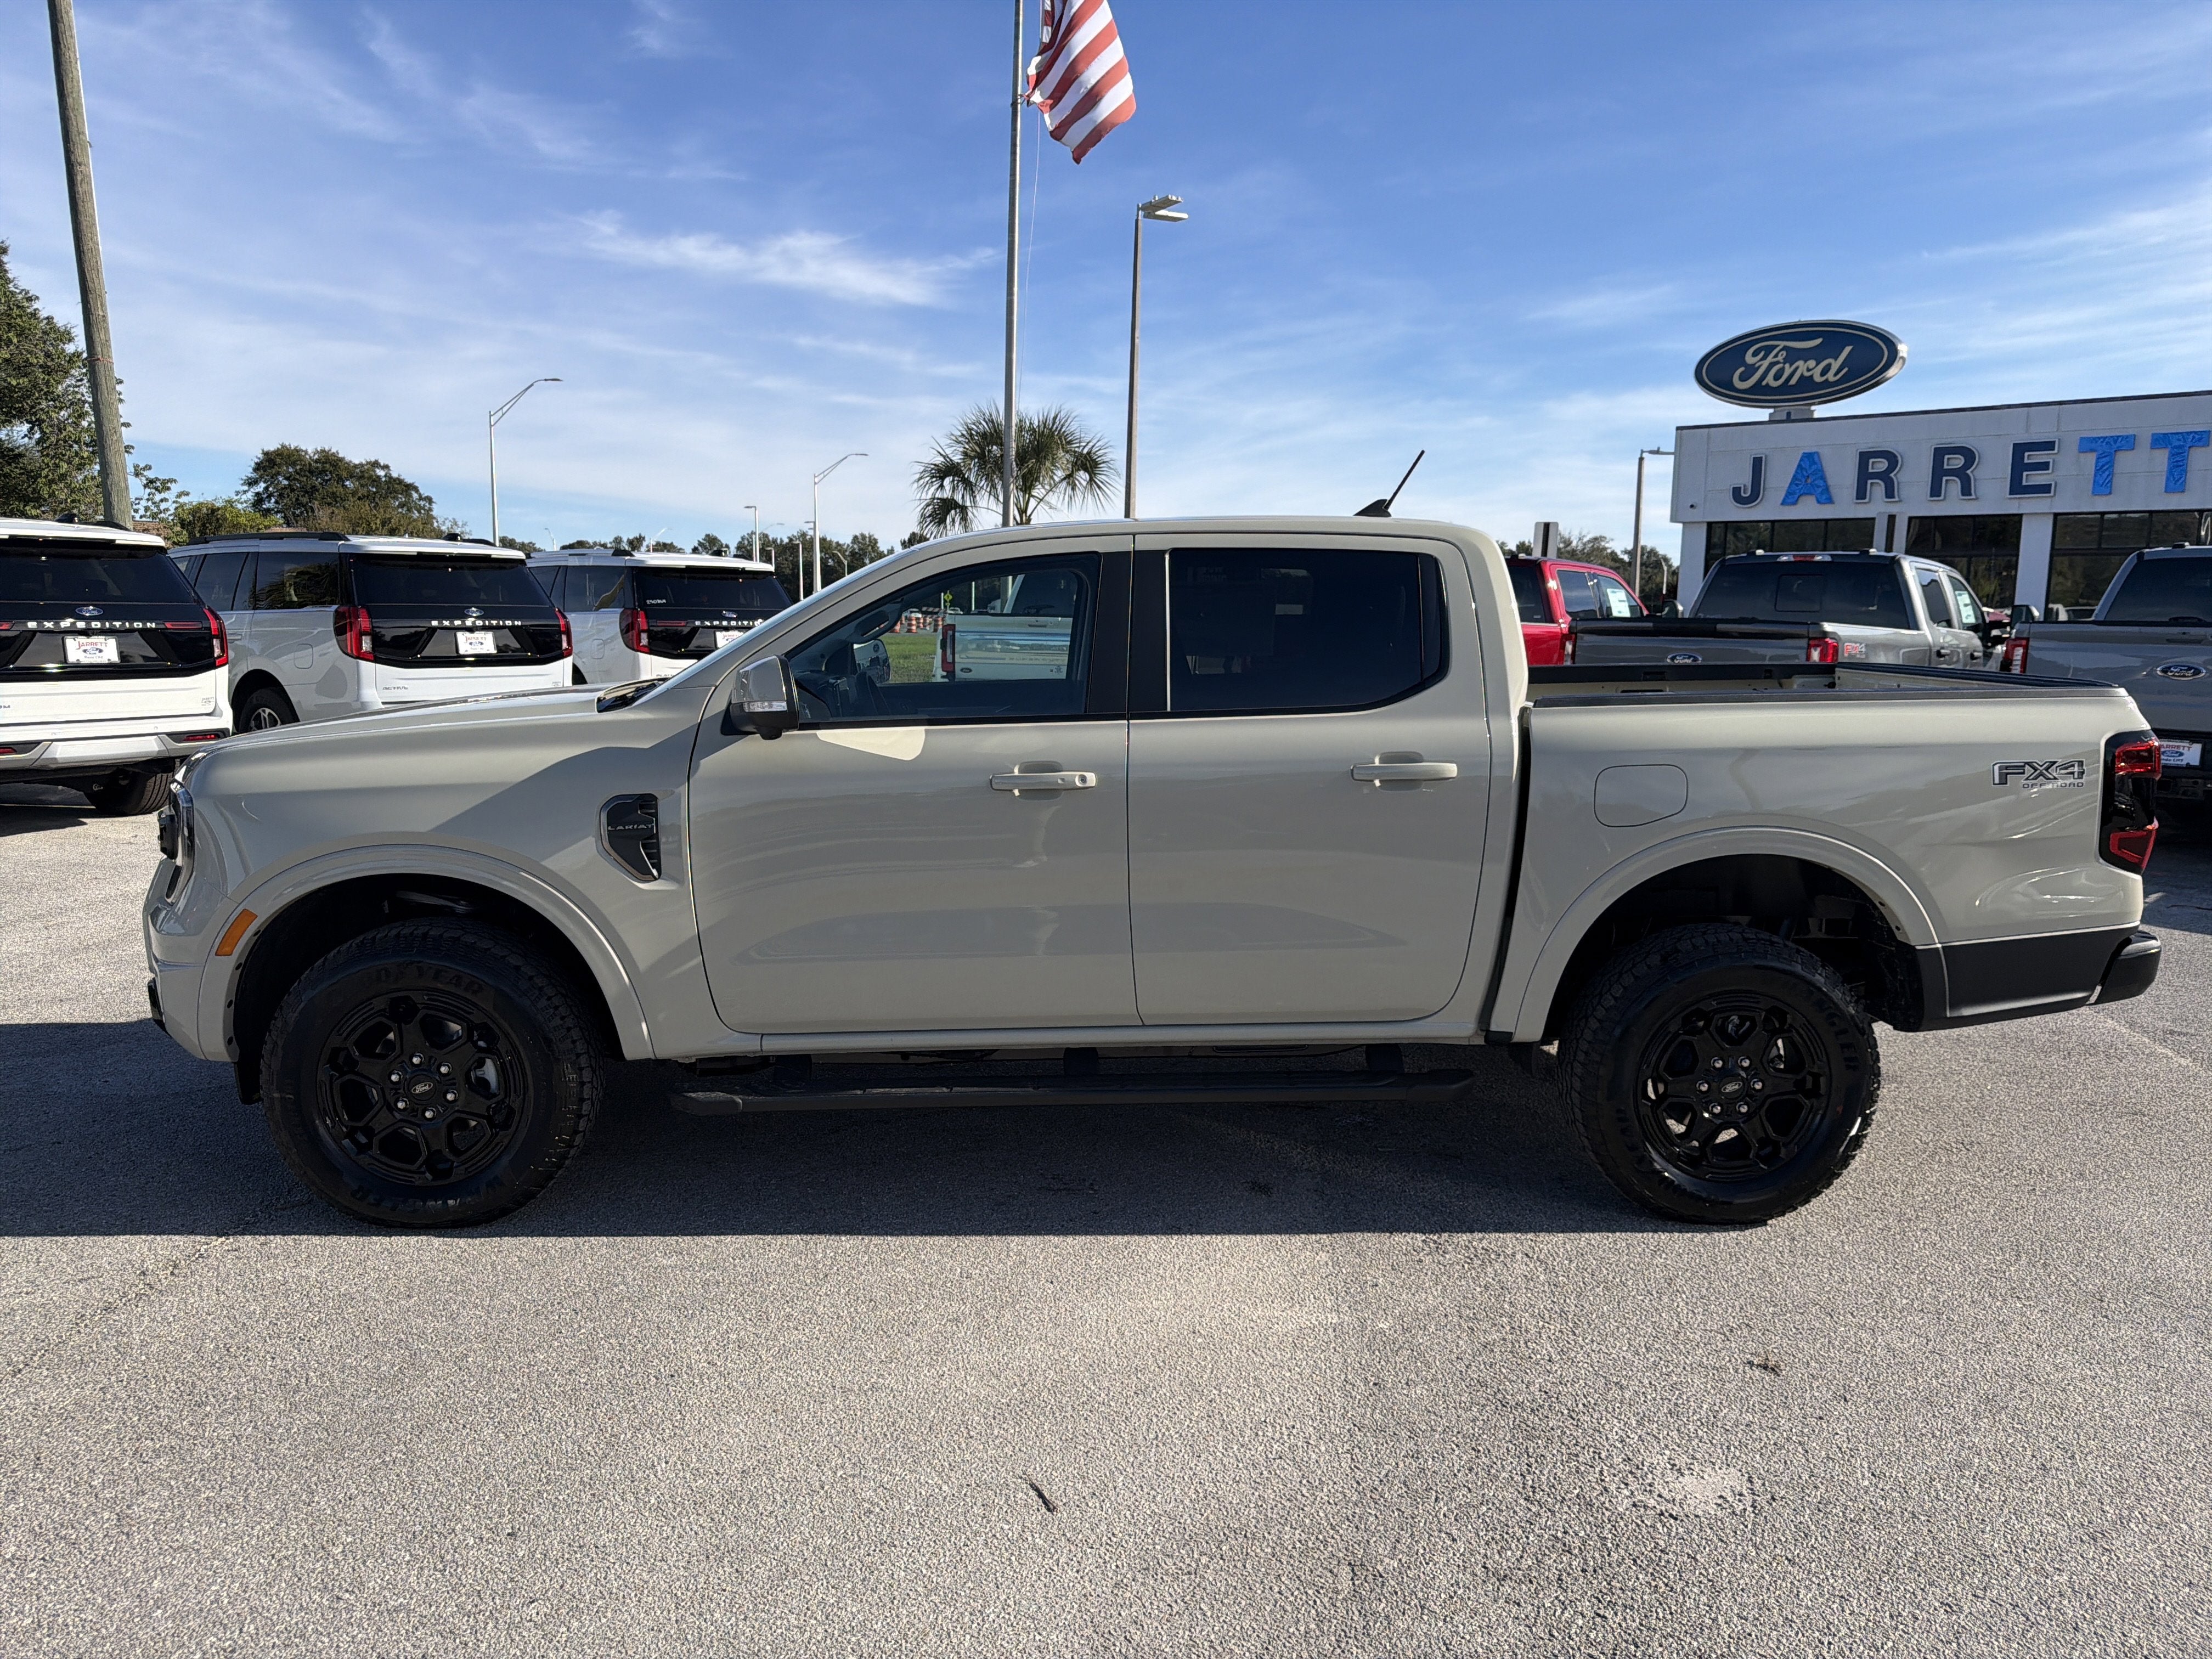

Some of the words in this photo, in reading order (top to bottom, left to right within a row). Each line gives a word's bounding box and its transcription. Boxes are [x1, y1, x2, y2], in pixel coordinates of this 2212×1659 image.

[1733, 338, 1854, 390] Ford
[1730, 430, 2210, 508] JARRETT
[76, 641, 108, 650] JARRETT
[2168, 667, 2194, 676] Ford
[1992, 760, 2085, 786] FX4
[415, 1084, 428, 1093] Ford
[1725, 1083, 1739, 1092] Ford
